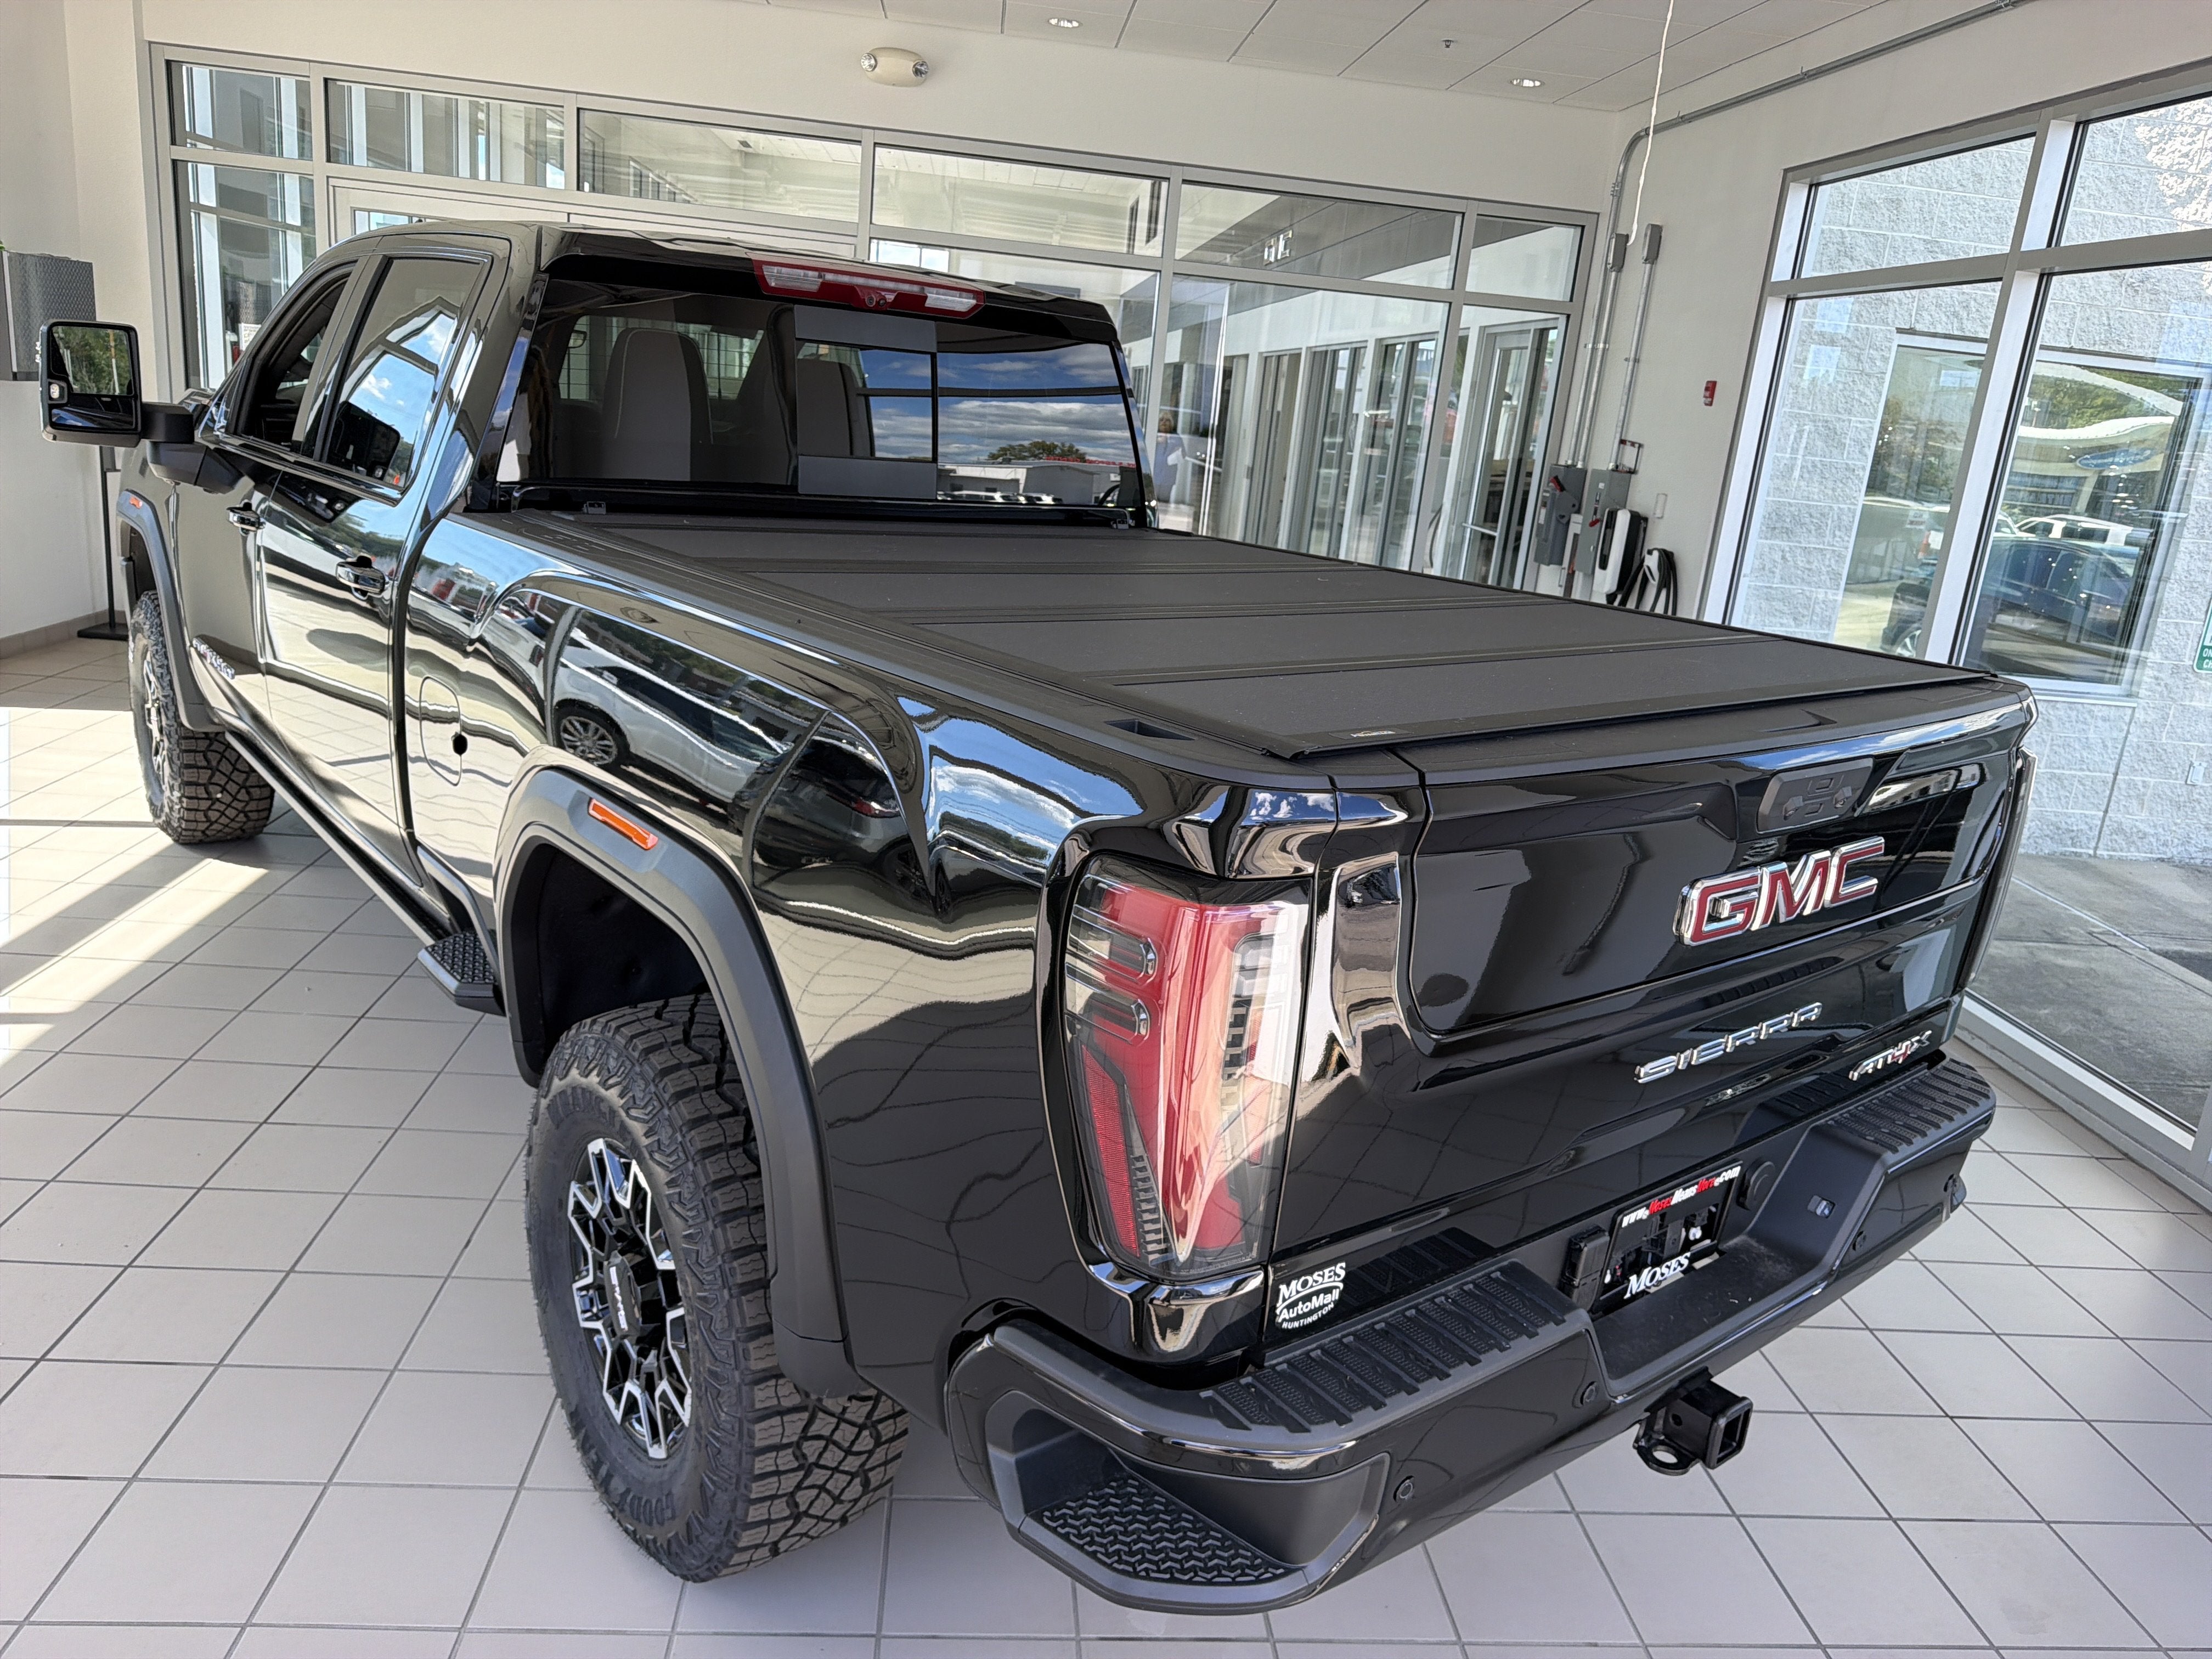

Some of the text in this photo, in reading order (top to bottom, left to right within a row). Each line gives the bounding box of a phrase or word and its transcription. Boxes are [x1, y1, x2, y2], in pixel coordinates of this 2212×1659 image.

[1673, 836, 1885, 946] GMC
[1634, 1002, 1822, 1084] SIERRA
[1848, 1030, 1932, 1081] AT4X
[1277, 1262, 1345, 1307] MOSES
[1623, 1252, 1691, 1299] MOSES
[1278, 1289, 1339, 1322] AutoMall
[1282, 1302, 1334, 1329] HUNTINGTON
